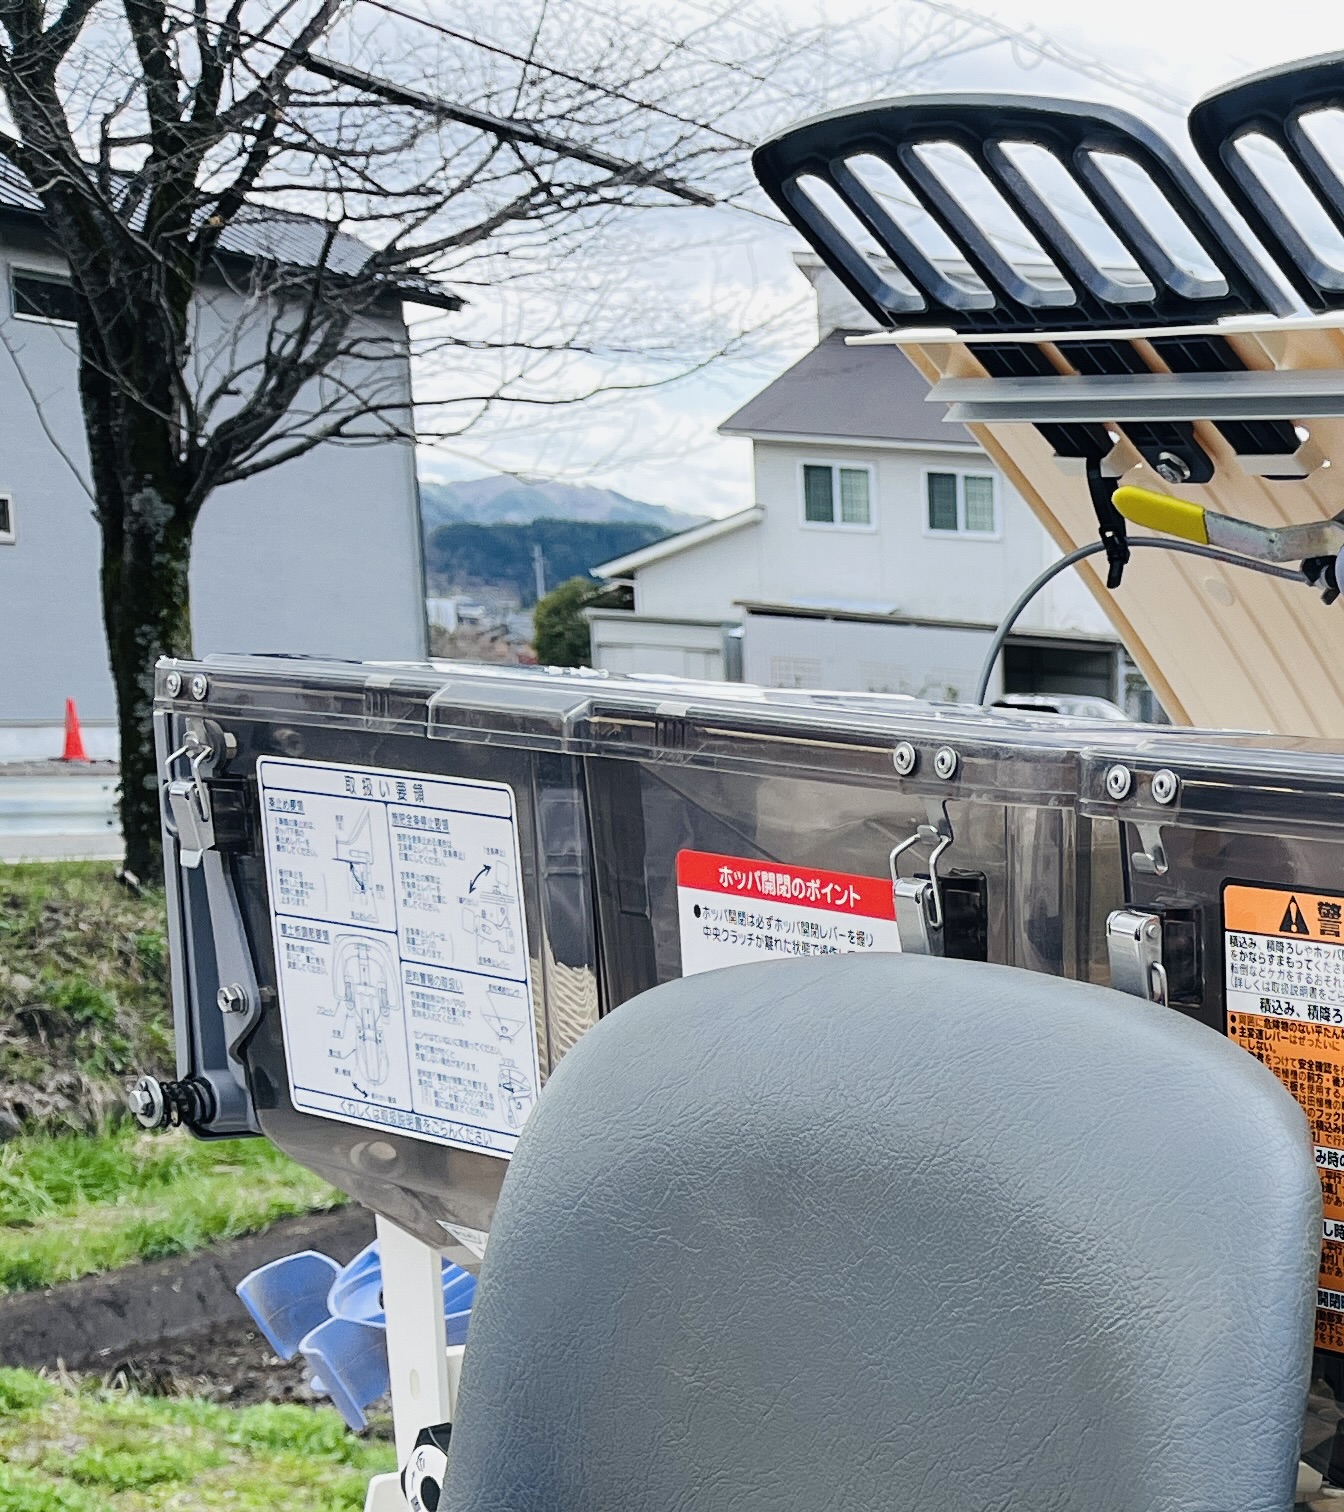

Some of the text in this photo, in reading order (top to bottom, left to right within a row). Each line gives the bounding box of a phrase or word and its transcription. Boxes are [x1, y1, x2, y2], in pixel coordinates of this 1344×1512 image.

[344, 774, 425, 803] 取扱い要領
[717, 865, 861, 908] ホッパ開閉のポイント
